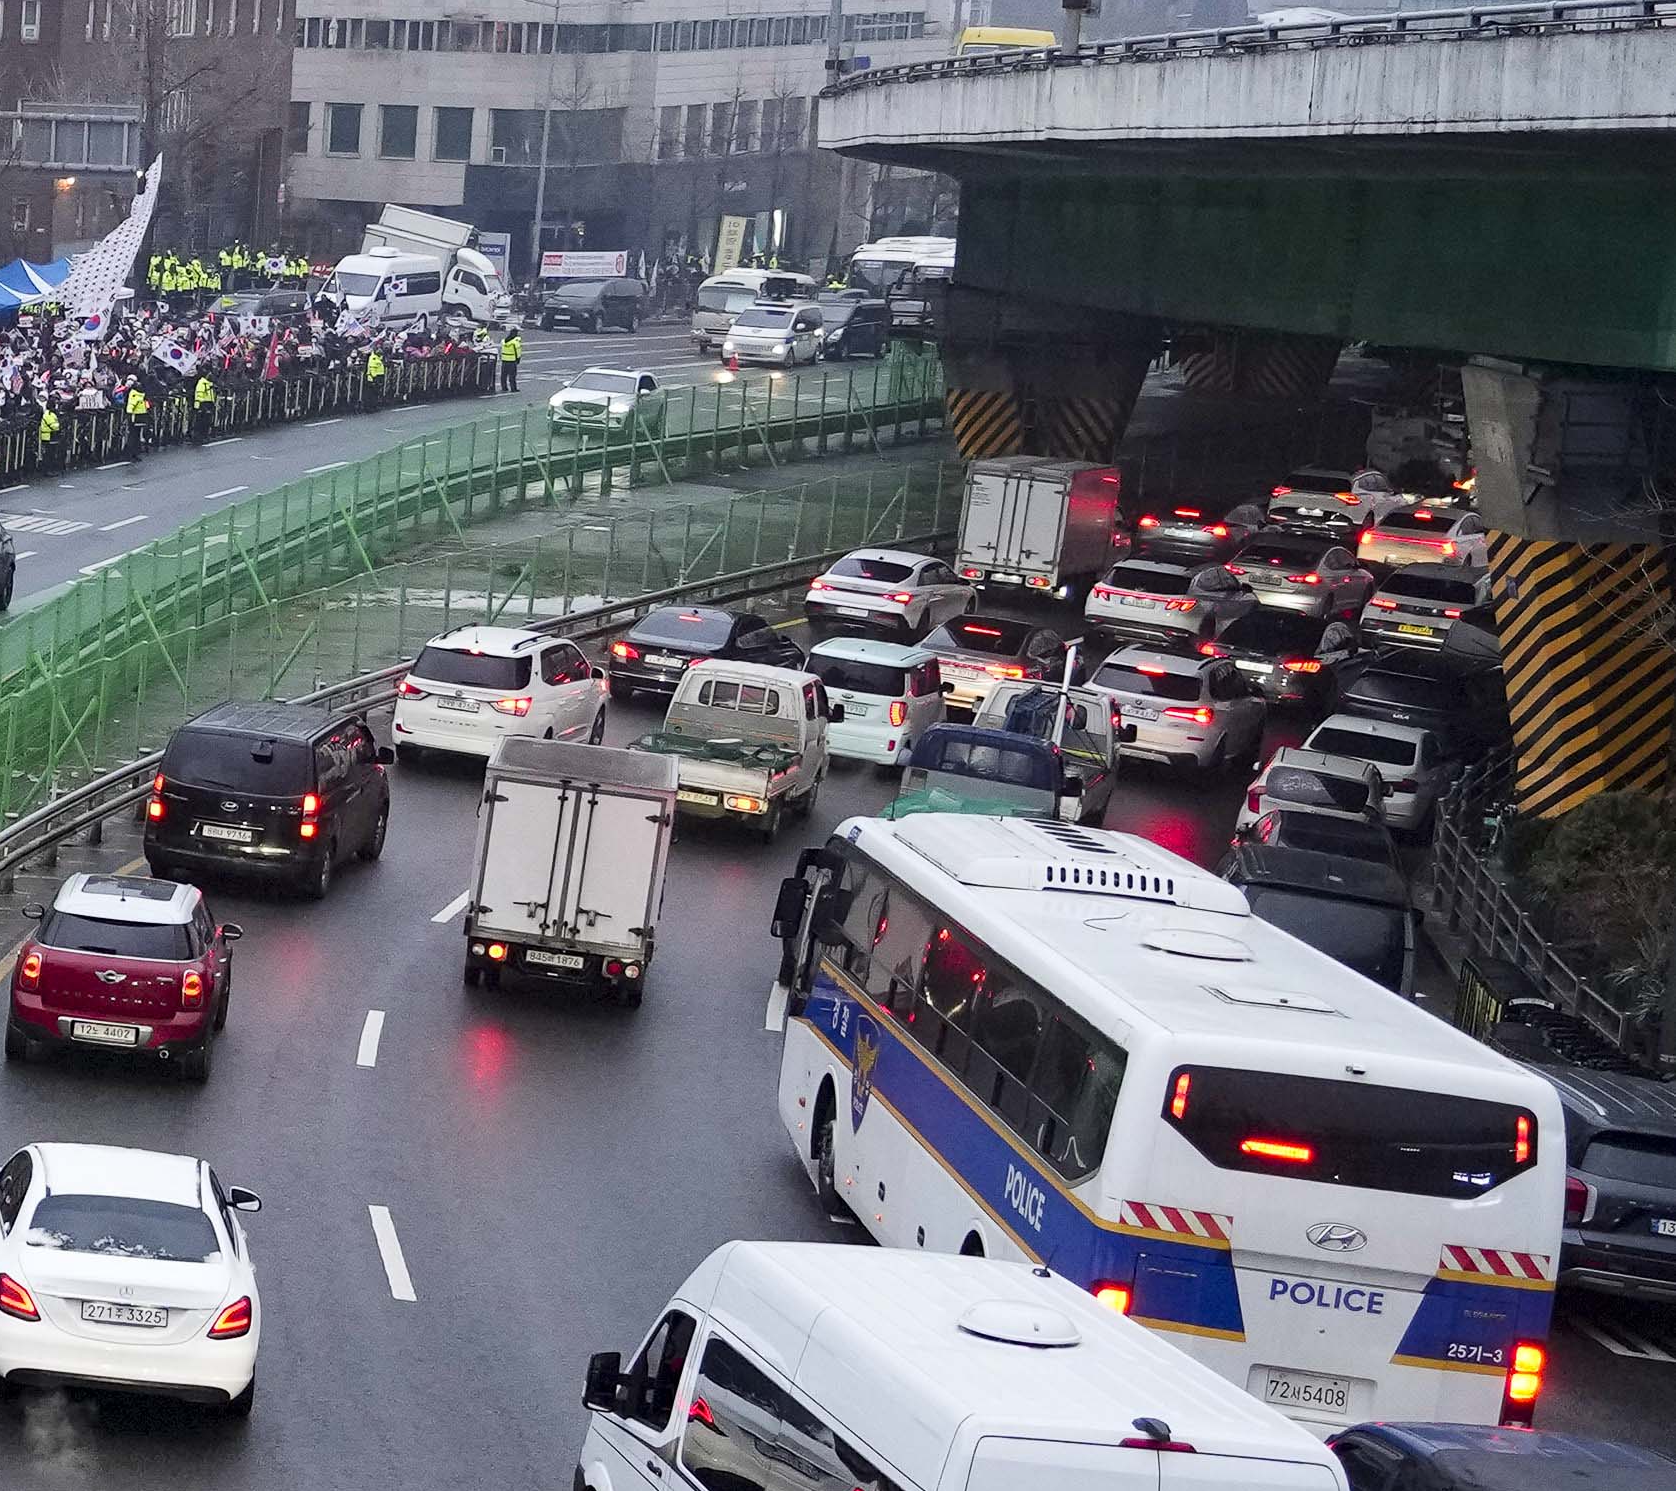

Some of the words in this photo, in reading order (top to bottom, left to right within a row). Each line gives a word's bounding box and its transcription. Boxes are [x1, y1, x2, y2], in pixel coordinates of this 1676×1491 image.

[557, 954, 580, 967] 1876
[831, 997, 849, 1038] 경찰
[1004, 1164, 1046, 1232] POLICE
[1269, 1279, 1384, 1315] POLICE
[126, 1308, 162, 1324] 3325
[1448, 1342, 1503, 1364] 25기-3
